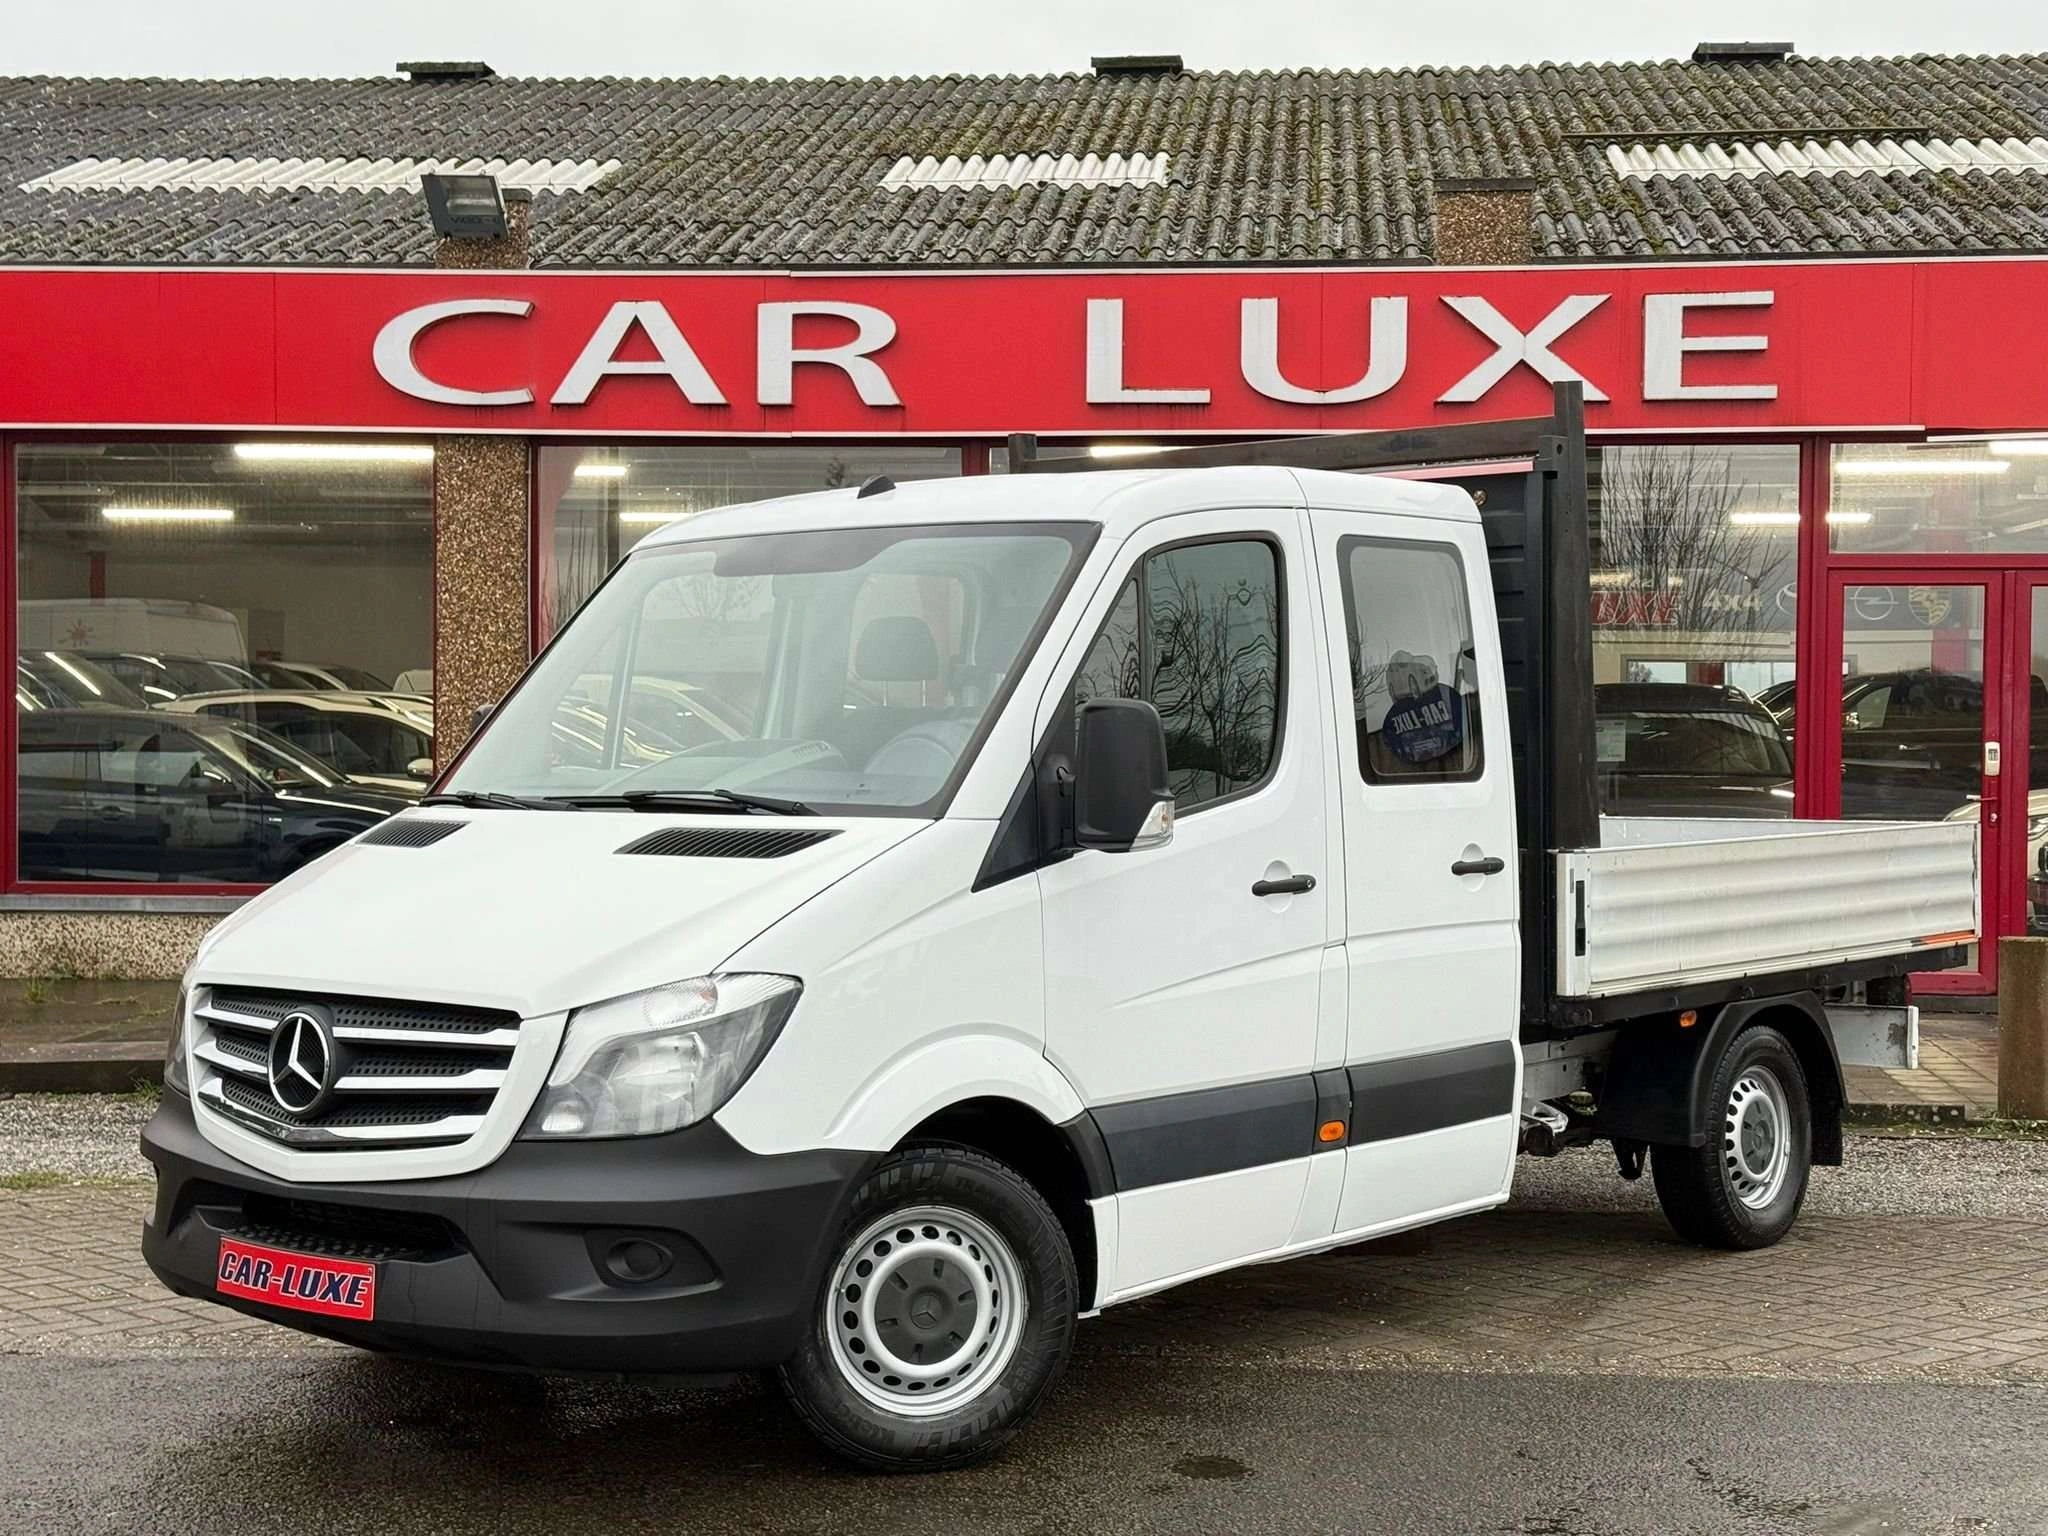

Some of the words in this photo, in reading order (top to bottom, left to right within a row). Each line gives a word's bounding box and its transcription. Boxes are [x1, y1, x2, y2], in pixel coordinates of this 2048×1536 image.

[372, 298, 904, 407] CAR
[1086, 290, 1779, 405] LUXE
[1590, 590, 1681, 626] UXE
[218, 1250, 373, 1310] CAR-LUXE
